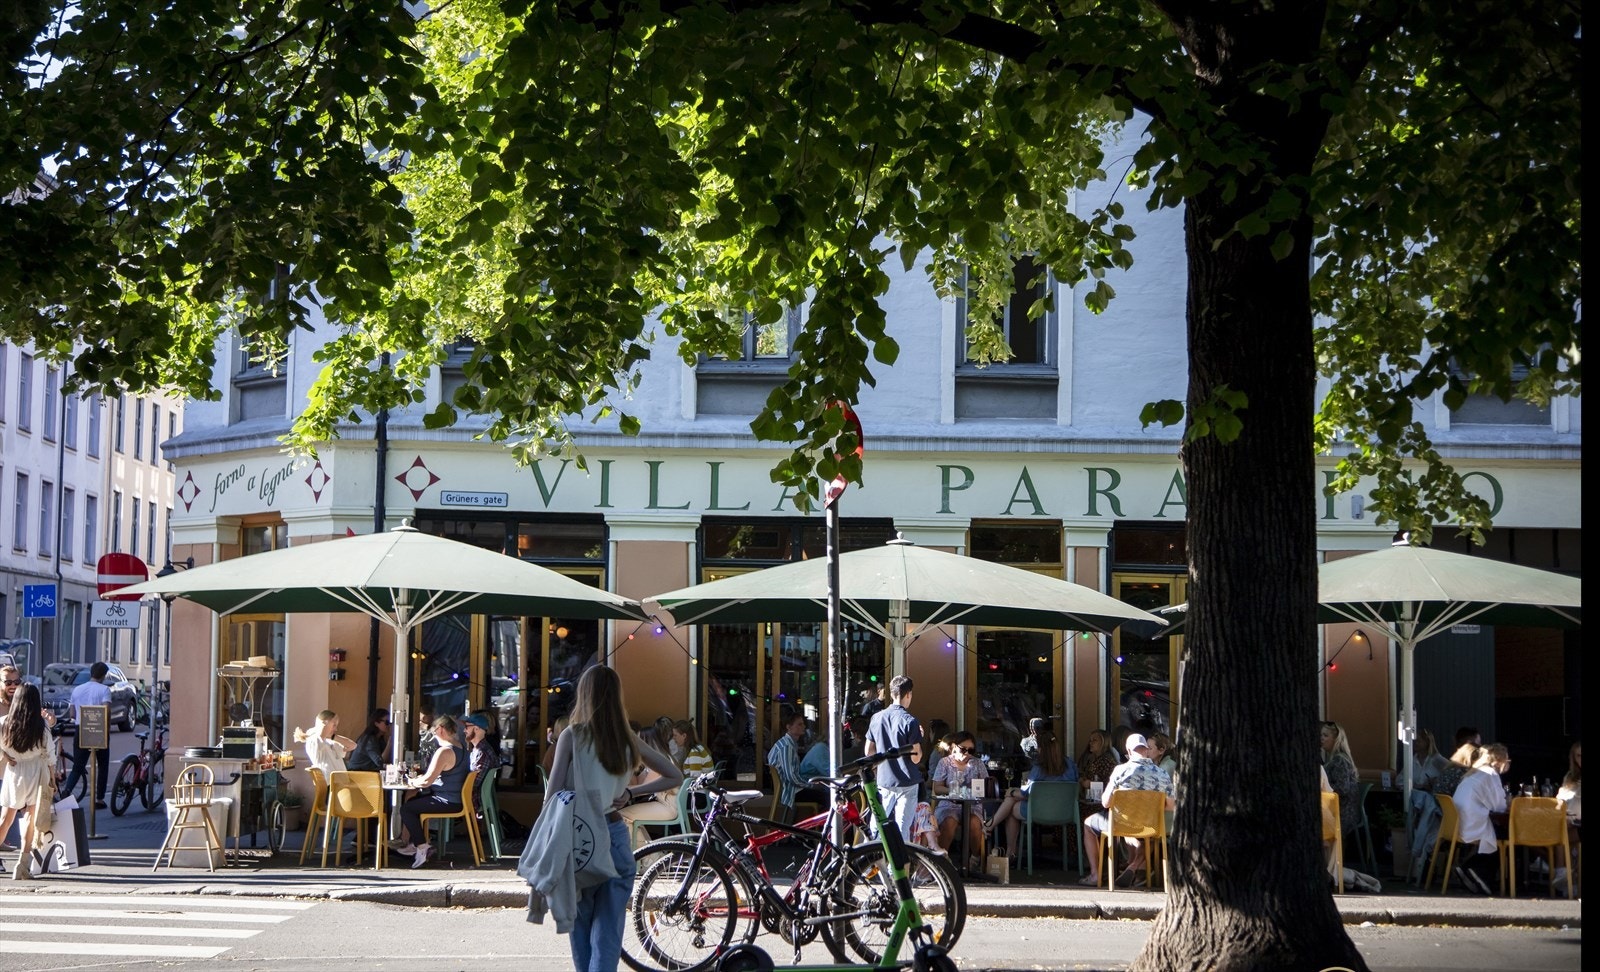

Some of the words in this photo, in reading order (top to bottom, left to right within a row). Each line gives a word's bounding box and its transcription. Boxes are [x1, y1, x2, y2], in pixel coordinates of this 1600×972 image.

[208, 463, 246, 513] forno
[247, 475, 256, 492] a
[259, 459, 295, 507] legna
[445, 493, 479, 503] Grüners
[483, 496, 503, 506] gate
[529, 458, 821, 512] VILLA
